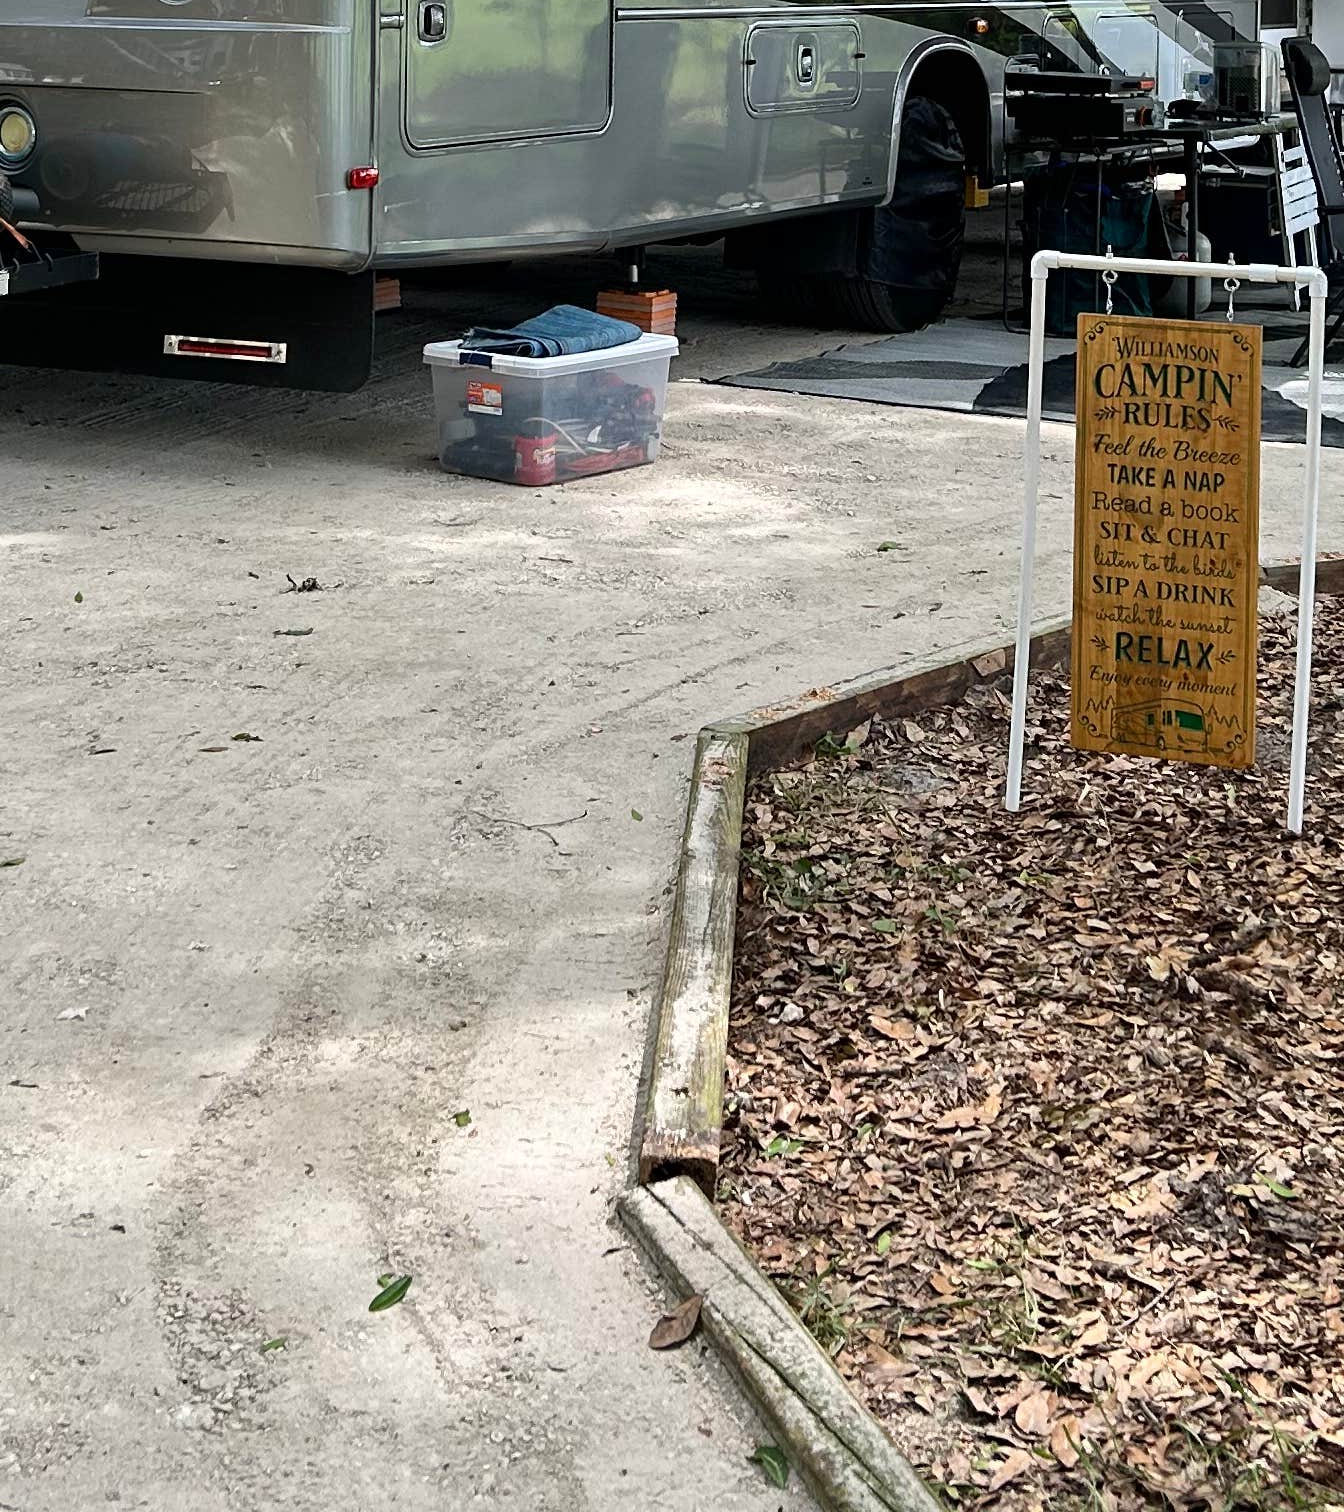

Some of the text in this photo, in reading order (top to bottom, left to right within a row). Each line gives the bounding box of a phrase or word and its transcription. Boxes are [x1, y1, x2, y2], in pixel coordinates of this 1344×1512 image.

[1094, 363, 1242, 408] CAMPIN'
[1123, 402, 1212, 434] RULES
[1094, 434, 1242, 467] Feel the Breeze
[1107, 463, 1226, 494] TAKE A NAP
[1091, 491, 1241, 524] Read a book
[1099, 522, 1230, 551] SIT & CHAT
[1093, 543, 1237, 580] listen to the birds
[1092, 574, 1236, 609] SIP A DRINK
[1095, 602, 1236, 635] watch the sunset
[1115, 632, 1215, 672] RELAX
[1088, 664, 1237, 698] Enjoy every moment
